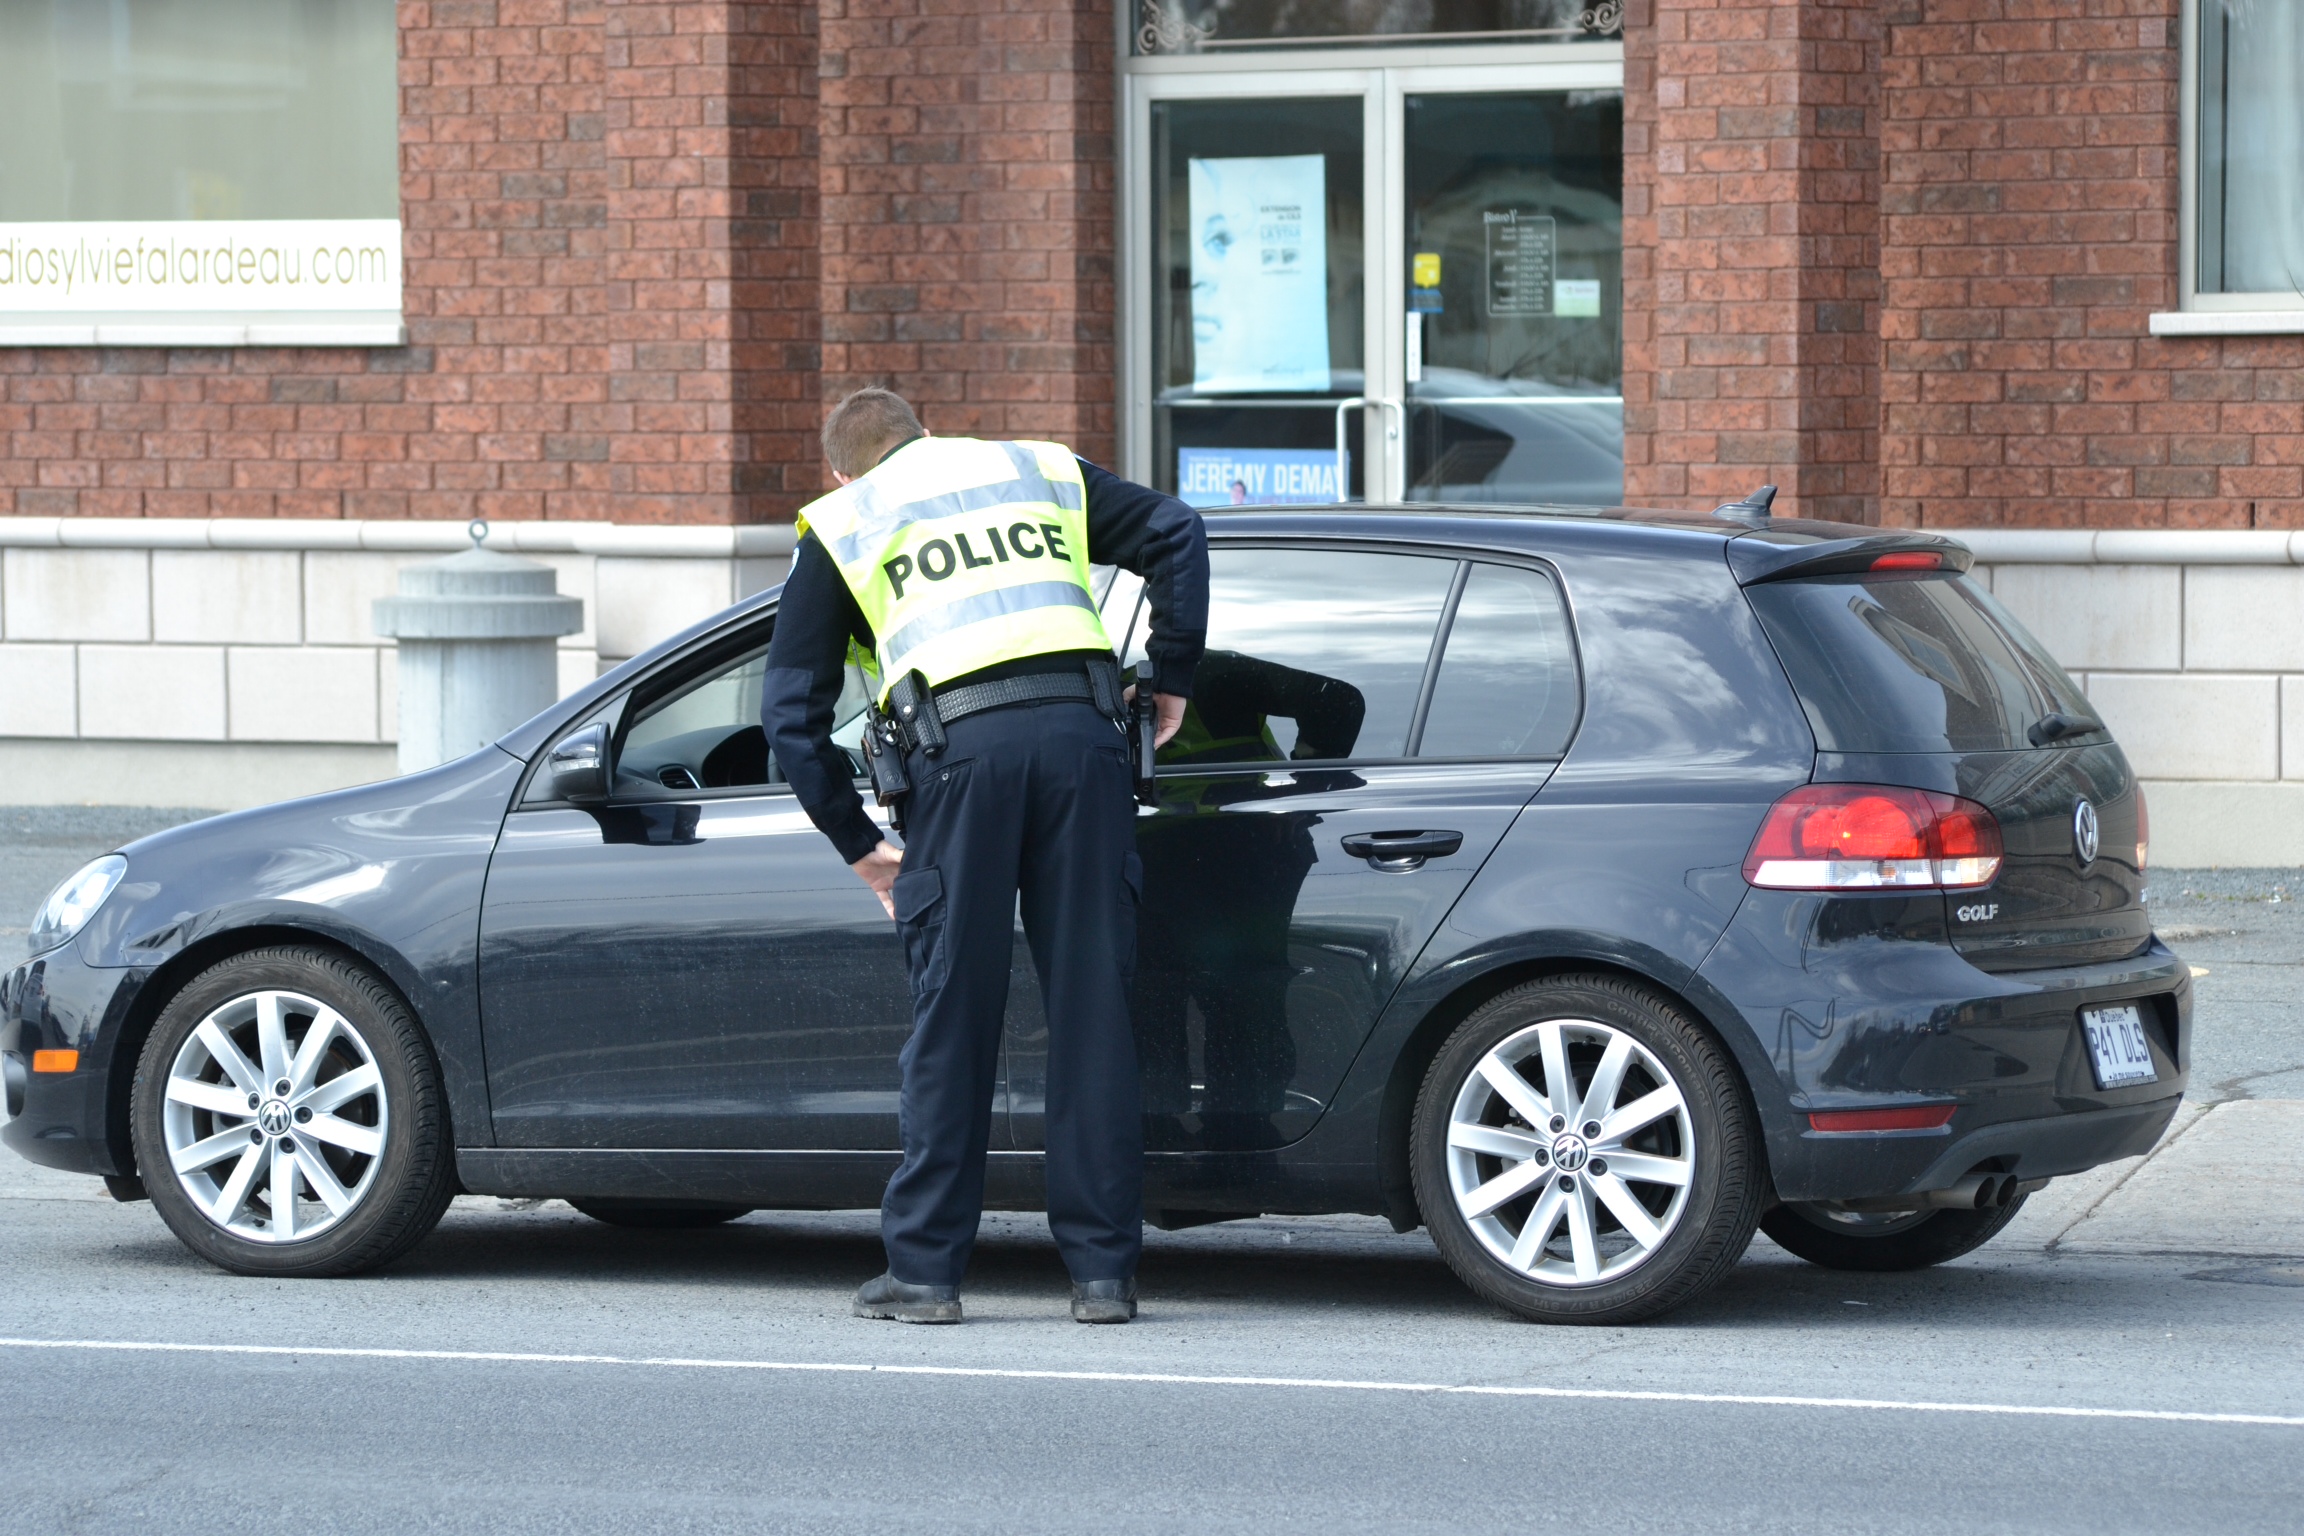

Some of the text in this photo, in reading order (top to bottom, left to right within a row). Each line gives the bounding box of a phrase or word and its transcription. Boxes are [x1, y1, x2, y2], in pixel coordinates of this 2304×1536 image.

[0, 236, 387, 296] diosylviefalardeau.com
[883, 522, 1072, 600] POLICE
[1957, 904, 1999, 922] GOLF
[2088, 1022, 2149, 1067] P41 DLS
[1602, 1277, 1655, 1307] 225/45
